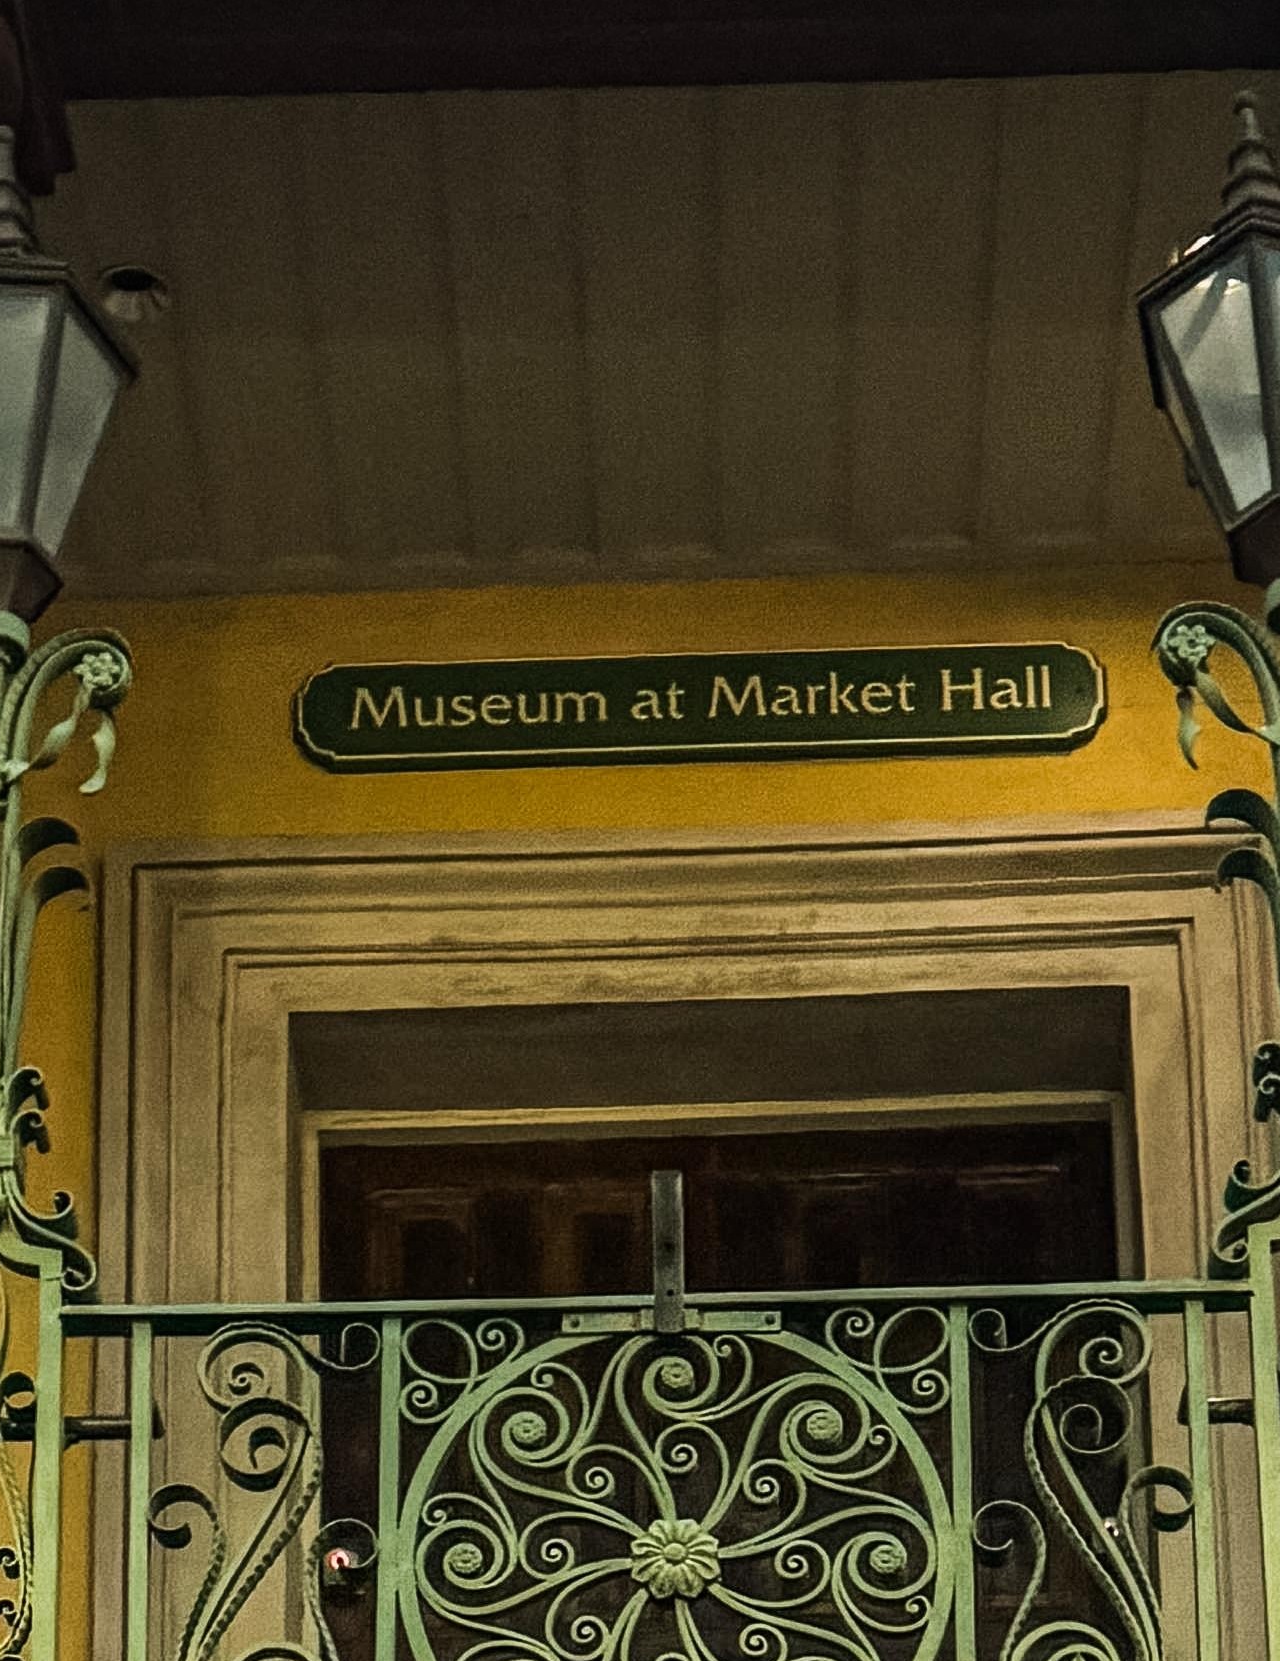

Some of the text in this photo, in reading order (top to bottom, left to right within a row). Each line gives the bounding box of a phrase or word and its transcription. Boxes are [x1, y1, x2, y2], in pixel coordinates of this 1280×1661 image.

[350, 664, 1052, 730] Museum at Market Hall
